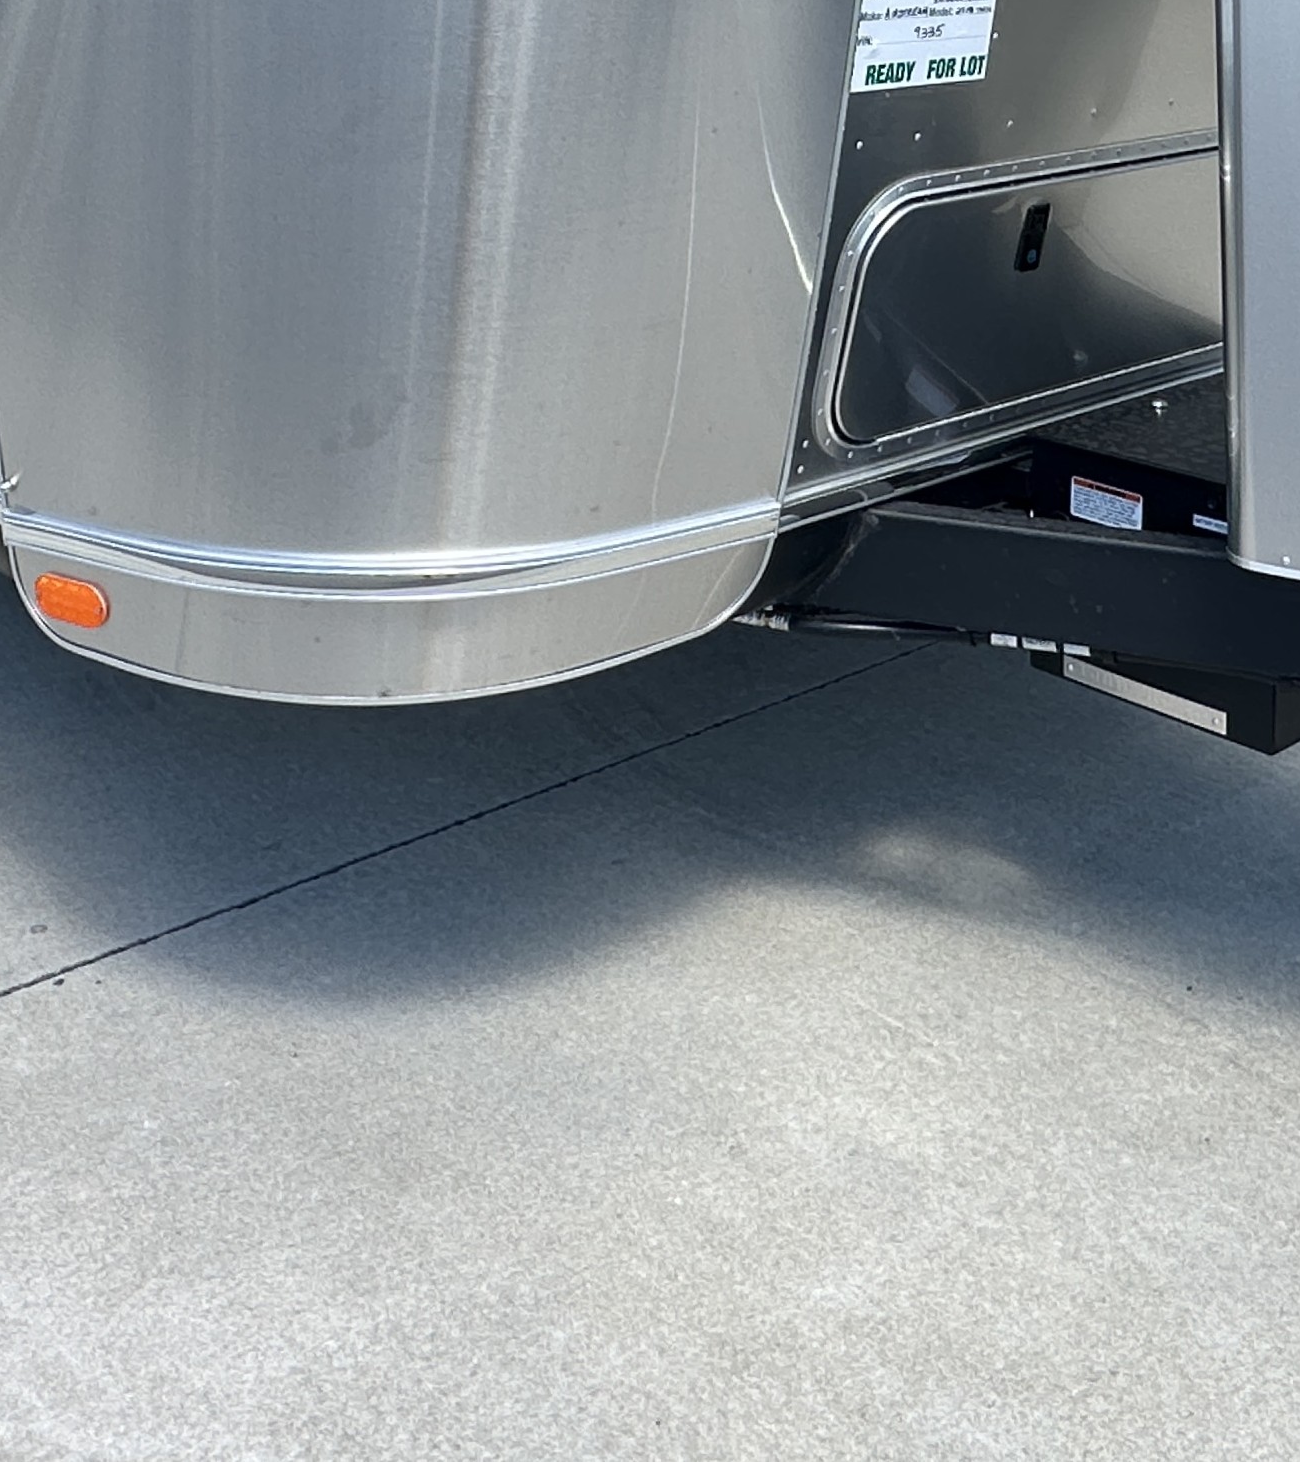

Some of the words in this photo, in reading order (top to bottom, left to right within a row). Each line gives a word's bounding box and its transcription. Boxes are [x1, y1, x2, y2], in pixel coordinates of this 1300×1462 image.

[864, 61, 917, 86] READY
[926, 57, 957, 80] FOR
[959, 55, 986, 77] LOT
